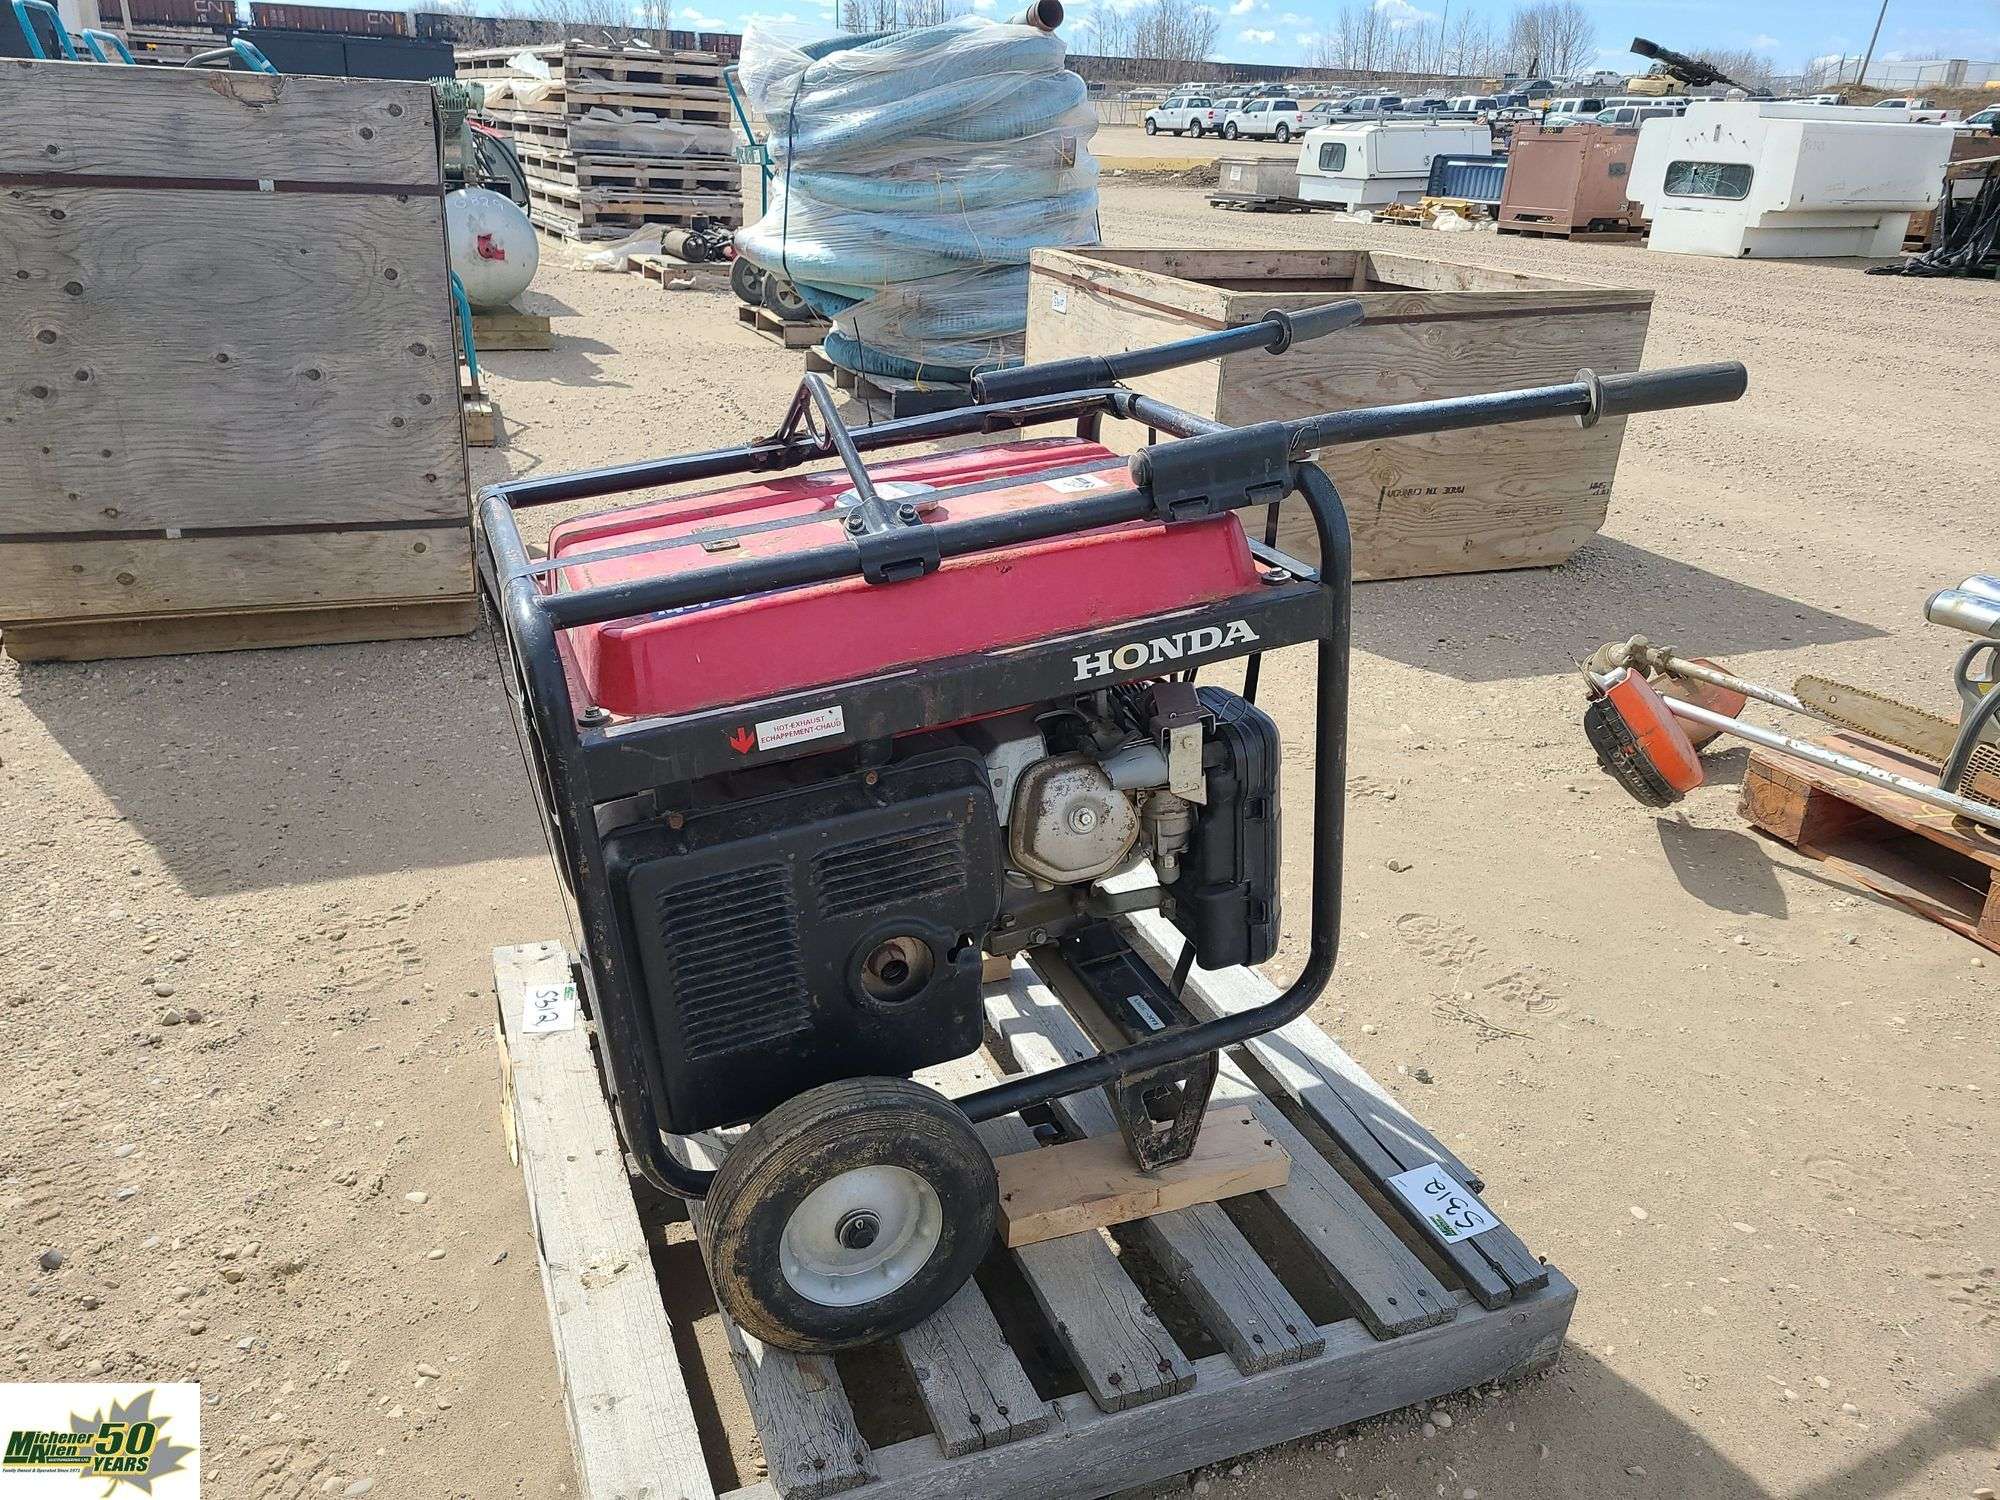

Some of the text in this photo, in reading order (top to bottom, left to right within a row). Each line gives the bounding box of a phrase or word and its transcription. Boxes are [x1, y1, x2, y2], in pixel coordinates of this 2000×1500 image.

[194, 0, 223, 13] CN
[367, 12, 394, 25] CN
[1072, 619, 1260, 682] HONDA
[760, 720, 842, 744] ECHAPPEMENT-CHAUD
[773, 716, 825, 732] HOT-EXHAUST
